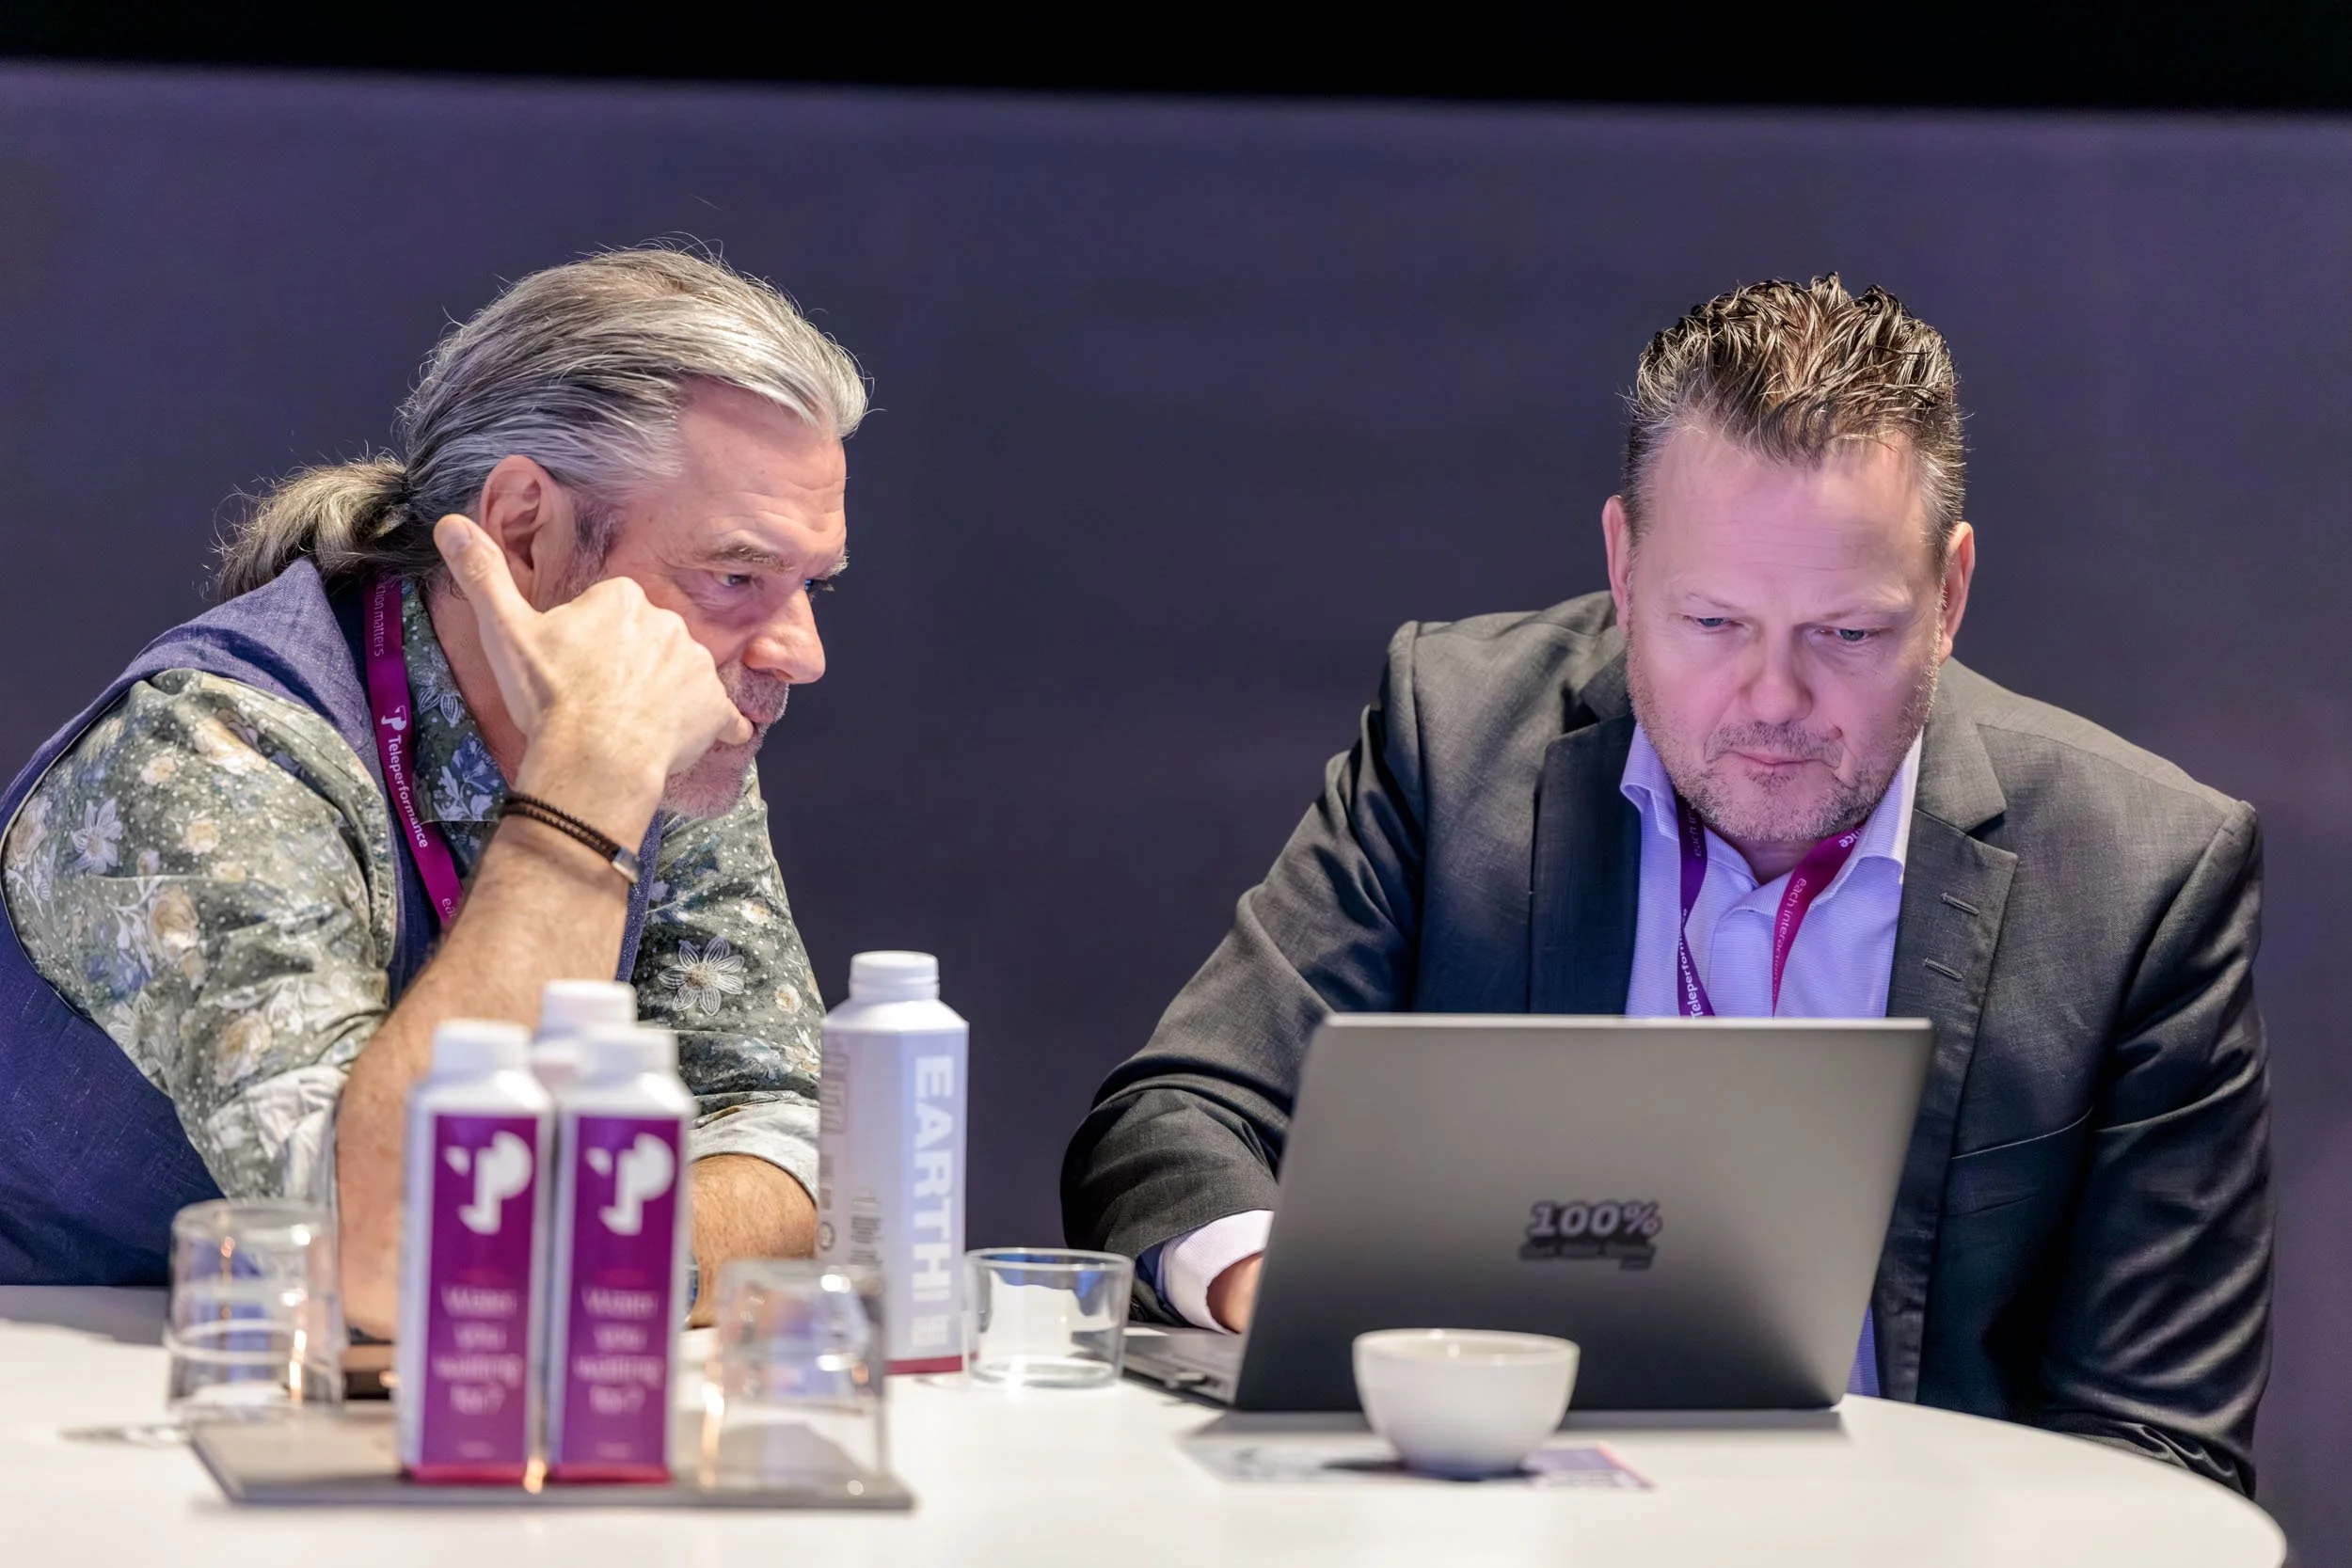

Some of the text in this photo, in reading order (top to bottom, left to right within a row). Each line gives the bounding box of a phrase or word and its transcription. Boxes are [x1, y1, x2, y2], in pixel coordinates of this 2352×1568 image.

[373, 610, 385, 657] matters
[388, 735, 429, 848] Teleperformance
[1785, 878, 1807, 908] each
[912, 1055, 954, 1291] EARTH
[1530, 1205, 1661, 1237] 100%
